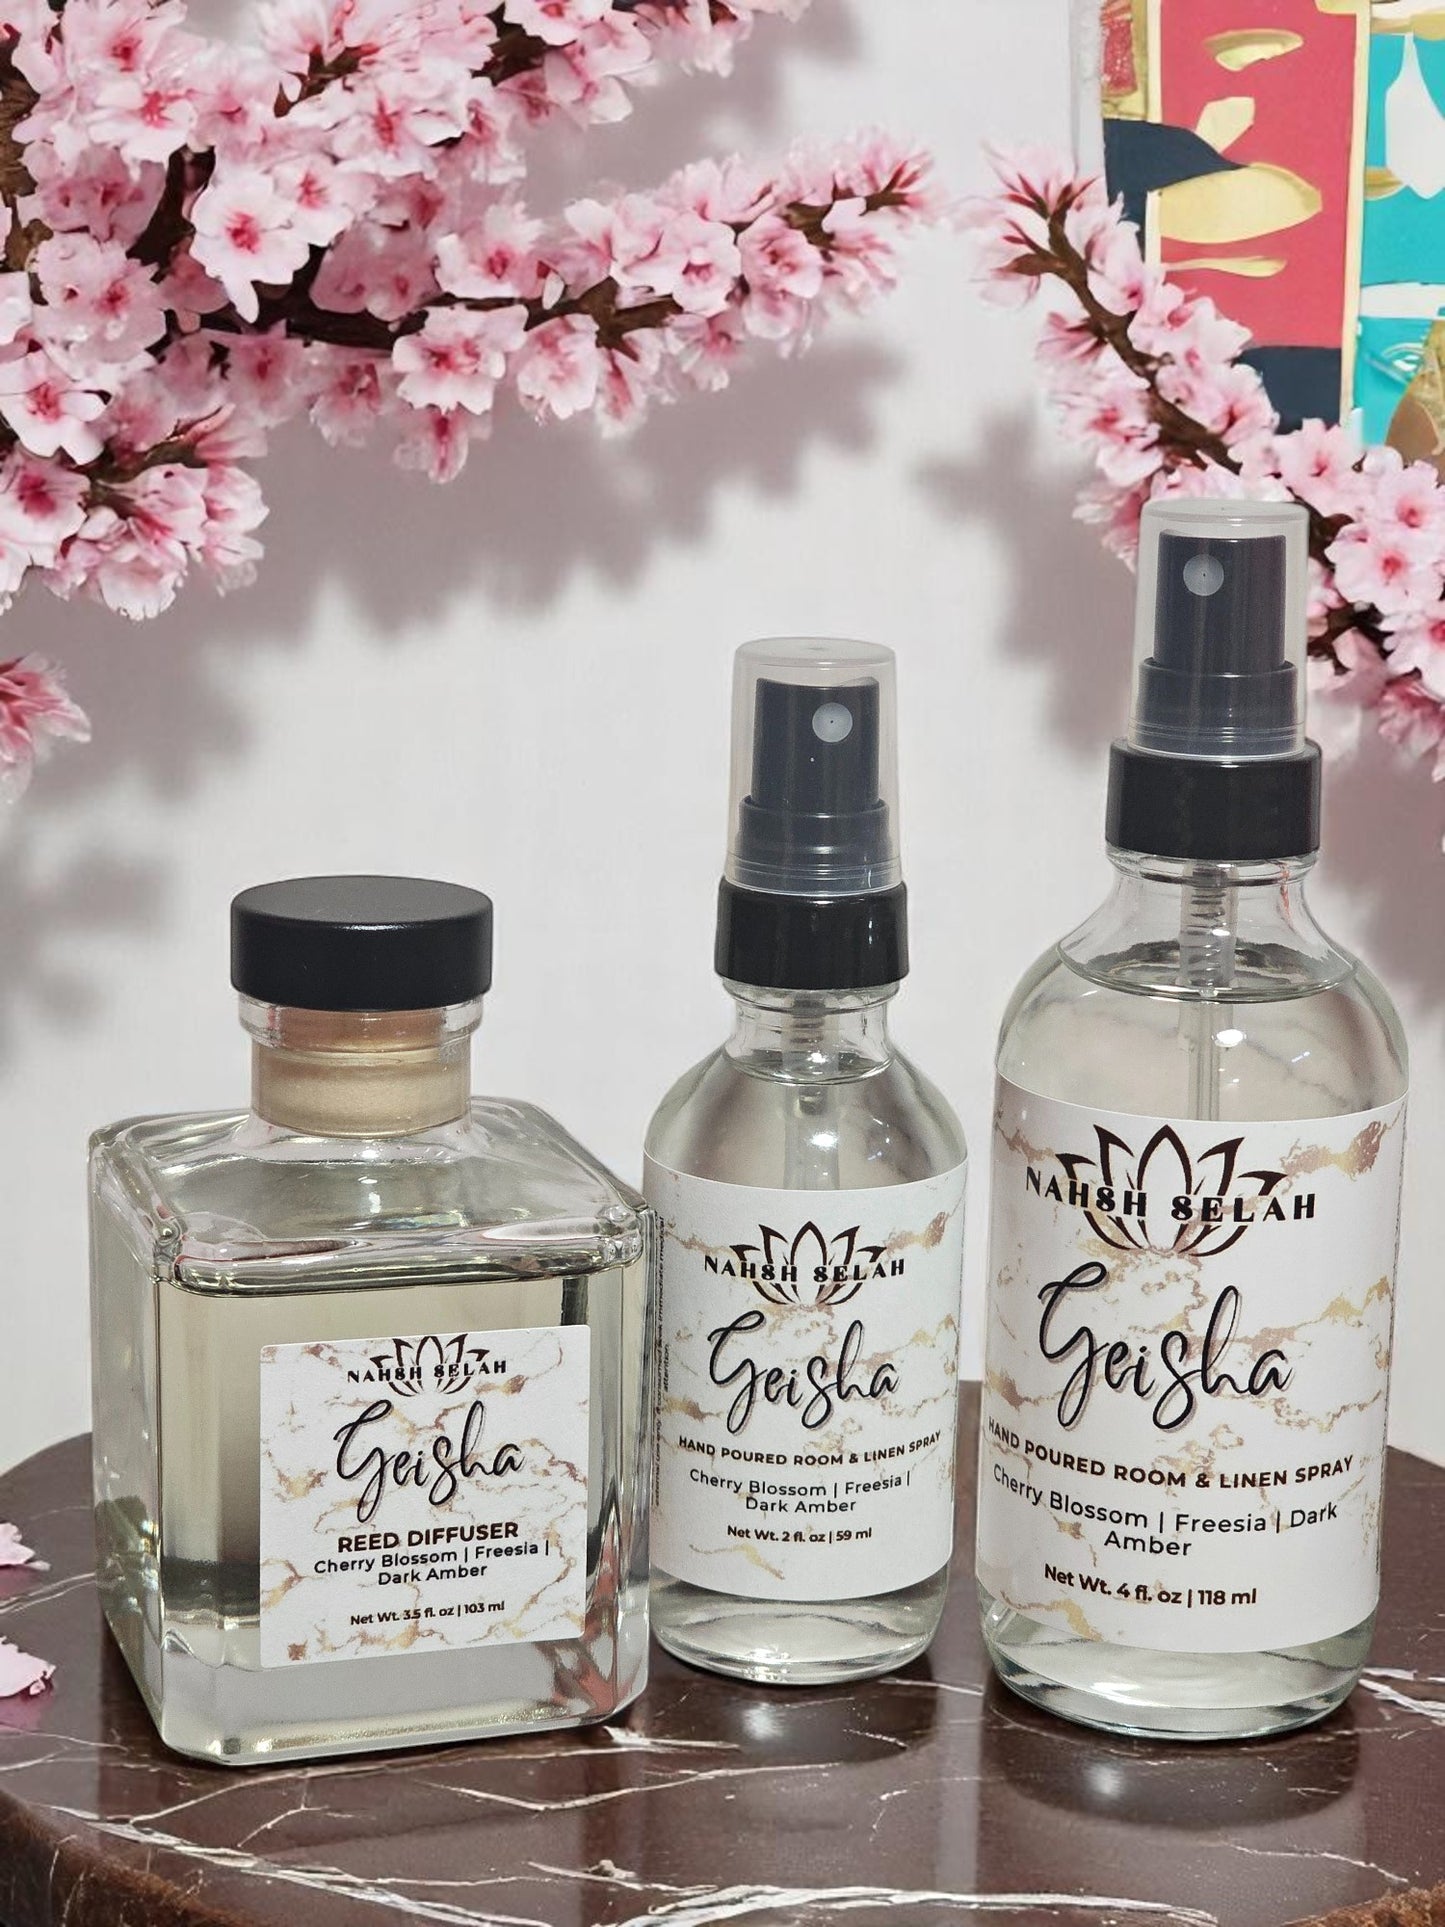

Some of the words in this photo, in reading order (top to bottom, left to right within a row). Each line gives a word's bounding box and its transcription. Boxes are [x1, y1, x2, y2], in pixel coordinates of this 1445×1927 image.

[1025, 1166, 1147, 1217] NAHSH
[1170, 1193, 1316, 1223] SELAH
[704, 1255, 798, 1282] NAHSH
[813, 1258, 905, 1283] SELAH
[1037, 1261, 1294, 1430] Geisha
[347, 1366, 422, 1384] NAHSH
[433, 1360, 507, 1378] SELAH
[707, 1310, 900, 1434] Geisha
[333, 1399, 525, 1523] Geisha
[678, 1435, 716, 1456] HAND
[720, 1447, 788, 1465] POURED
[793, 1455, 843, 1466] ROOM
[848, 1453, 859, 1464] &
[864, 1444, 905, 1462] LINEN
[908, 1430, 942, 1453] SPRAY
[988, 1416, 1020, 1449] HAND
[1024, 1439, 1106, 1476] POURED
[1114, 1464, 1187, 1488] ROOM
[1195, 1473, 1210, 1489] &
[1219, 1470, 1288, 1489] LINEN
[1294, 1455, 1354, 1484] SPRAY
[689, 1468, 743, 1494] Cherry
[749, 1480, 827, 1496] Blossom
[845, 1475, 902, 1494] Freesia
[745, 1496, 789, 1512] Dark
[794, 1500, 857, 1513] Amber
[993, 1463, 1043, 1506] Cherry
[1050, 1490, 1148, 1528] Blossom
[1175, 1513, 1267, 1533] Freesia
[1290, 1501, 1338, 1528] Dark
[338, 1532, 400, 1552] REED
[407, 1521, 519, 1547] DIFFUSER
[727, 1525, 751, 1539] Net
[754, 1529, 779, 1541] Wt.
[781, 1531, 791, 1542] 2
[793, 1531, 806, 1542] fl.
[809, 1533, 826, 1542] oz
[836, 1530, 852, 1541] 59
[855, 1527, 872, 1539] ml
[1104, 1530, 1192, 1556] Amber
[314, 1557, 375, 1574] Cherry
[381, 1550, 457, 1568] Blossom
[475, 1542, 539, 1559] Freesia
[378, 1569, 421, 1585] Dark
[425, 1564, 487, 1581] Amber
[1044, 1563, 1075, 1587] Net
[1078, 1573, 1112, 1595] Wt.
[1116, 1582, 1131, 1598] 4
[1134, 1584, 1152, 1602] fl.
[1157, 1590, 1182, 1604] oz
[1198, 1589, 1226, 1605] 118
[1231, 1588, 1257, 1605] ml
[350, 1614, 374, 1625] Net
[377, 1611, 399, 1623] Wt.
[424, 1607, 436, 1618] fl.
[438, 1606, 454, 1617] oz
[464, 1602, 485, 1614] 103
[488, 1601, 505, 1611] ml
